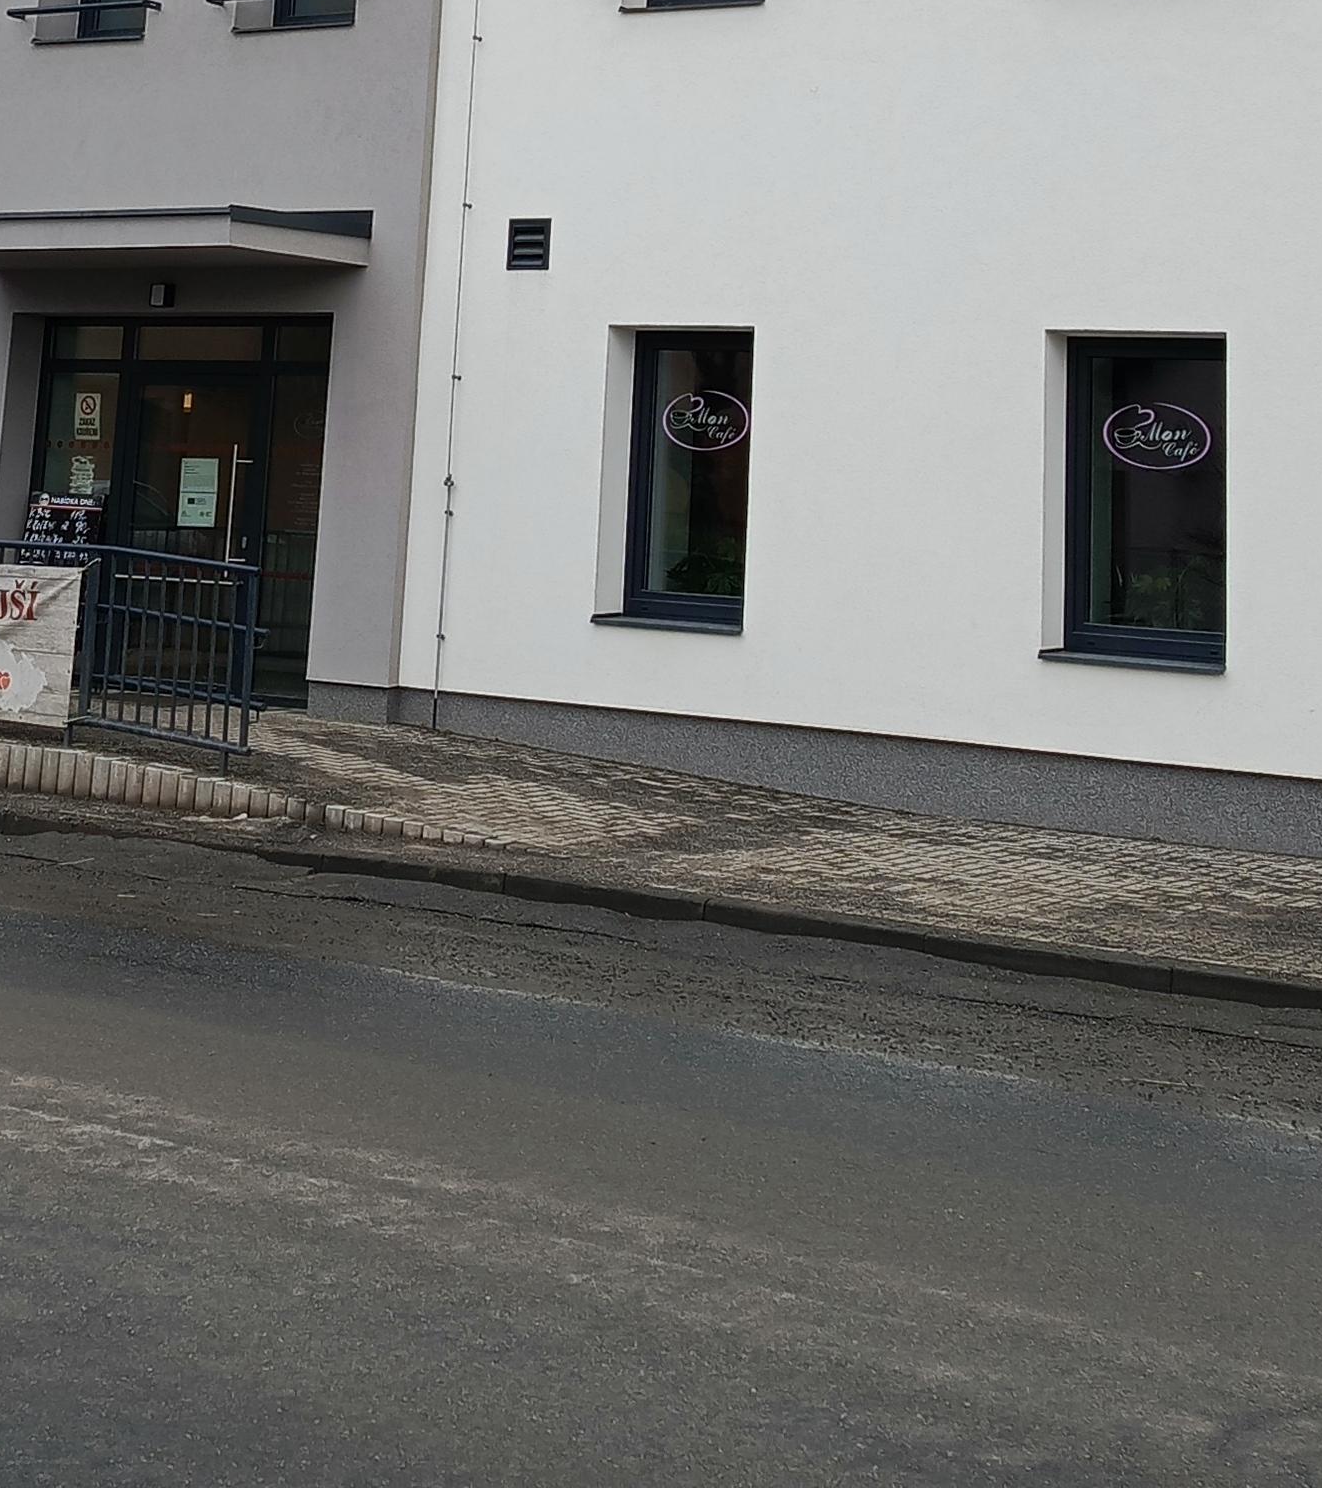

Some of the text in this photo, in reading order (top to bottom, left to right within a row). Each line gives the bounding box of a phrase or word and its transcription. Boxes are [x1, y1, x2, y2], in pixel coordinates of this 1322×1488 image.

[689, 407, 732, 425] Mon
[707, 425, 738, 444] Café
[1140, 421, 1192, 441] Mon
[1162, 441, 1201, 462] Café
